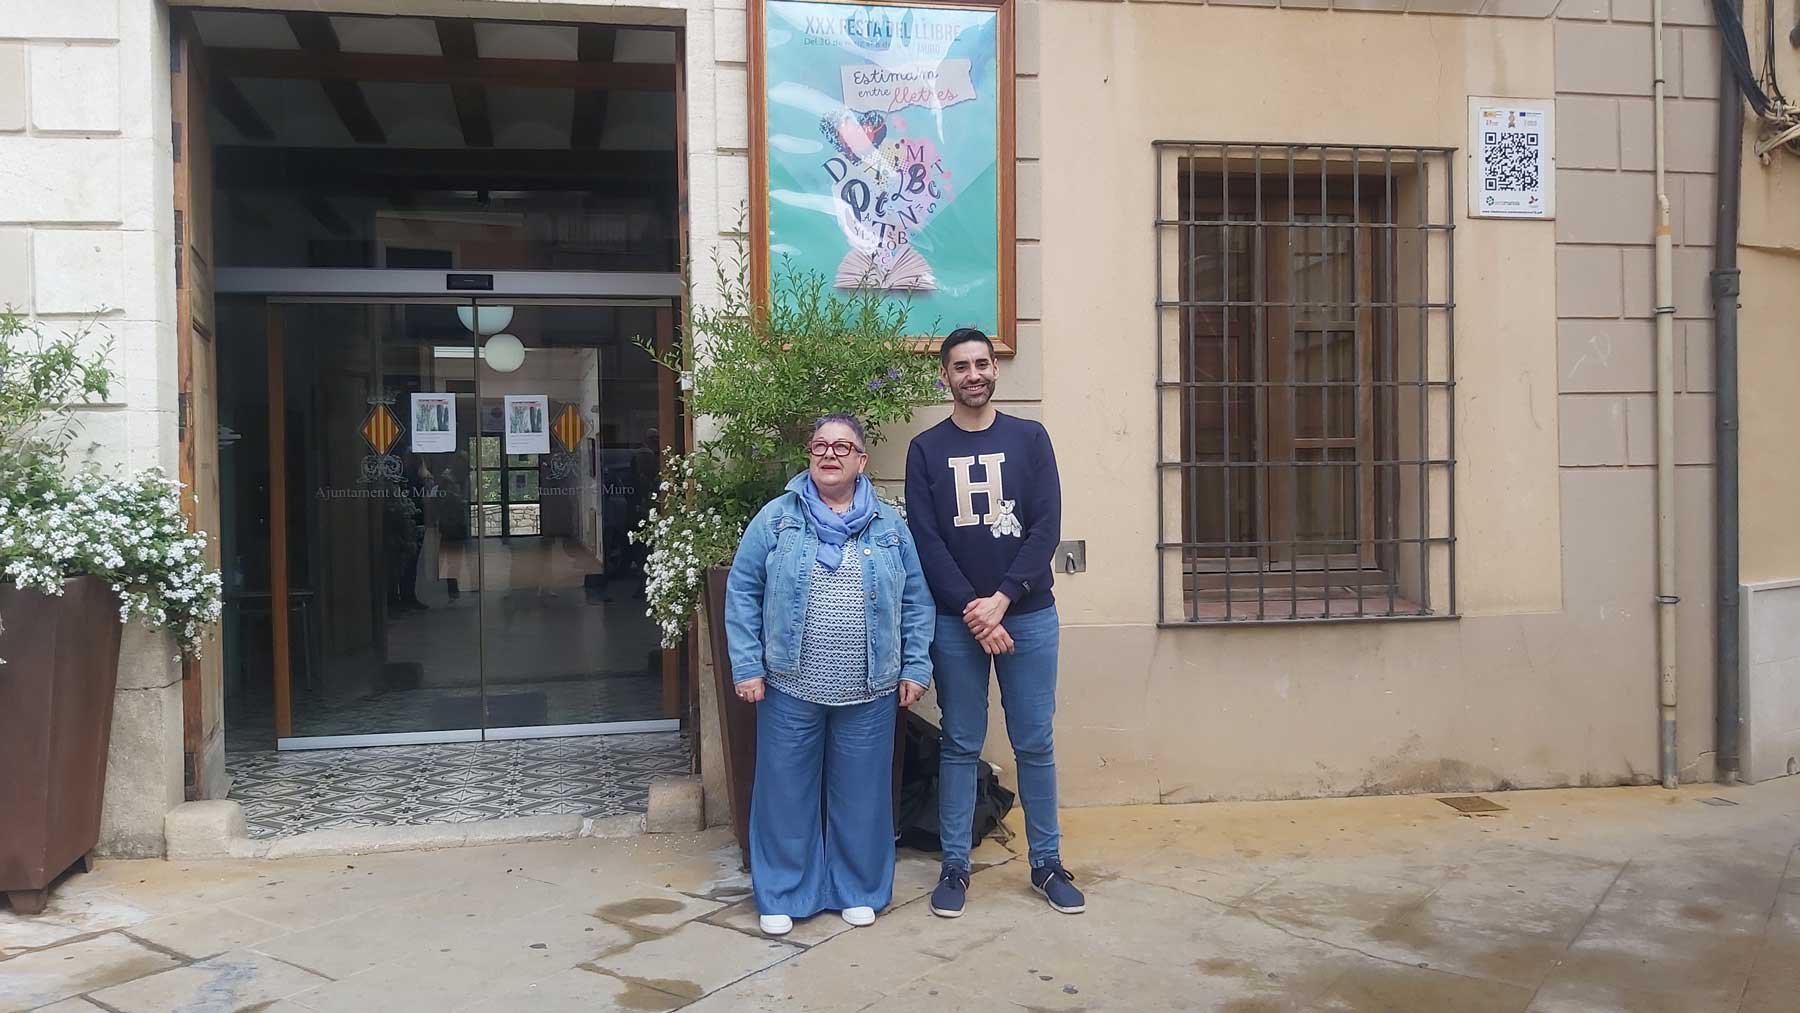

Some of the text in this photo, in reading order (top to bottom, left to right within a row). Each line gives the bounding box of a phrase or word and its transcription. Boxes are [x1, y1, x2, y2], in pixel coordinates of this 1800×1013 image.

[805, 16, 961, 42] XXX FESTA DEL LLIBRE
[858, 87, 891, 98] entre
[315, 486, 447, 500] Ajuntament de Muro
[602, 484, 635, 496] Muro
[948, 453, 1006, 527] H
